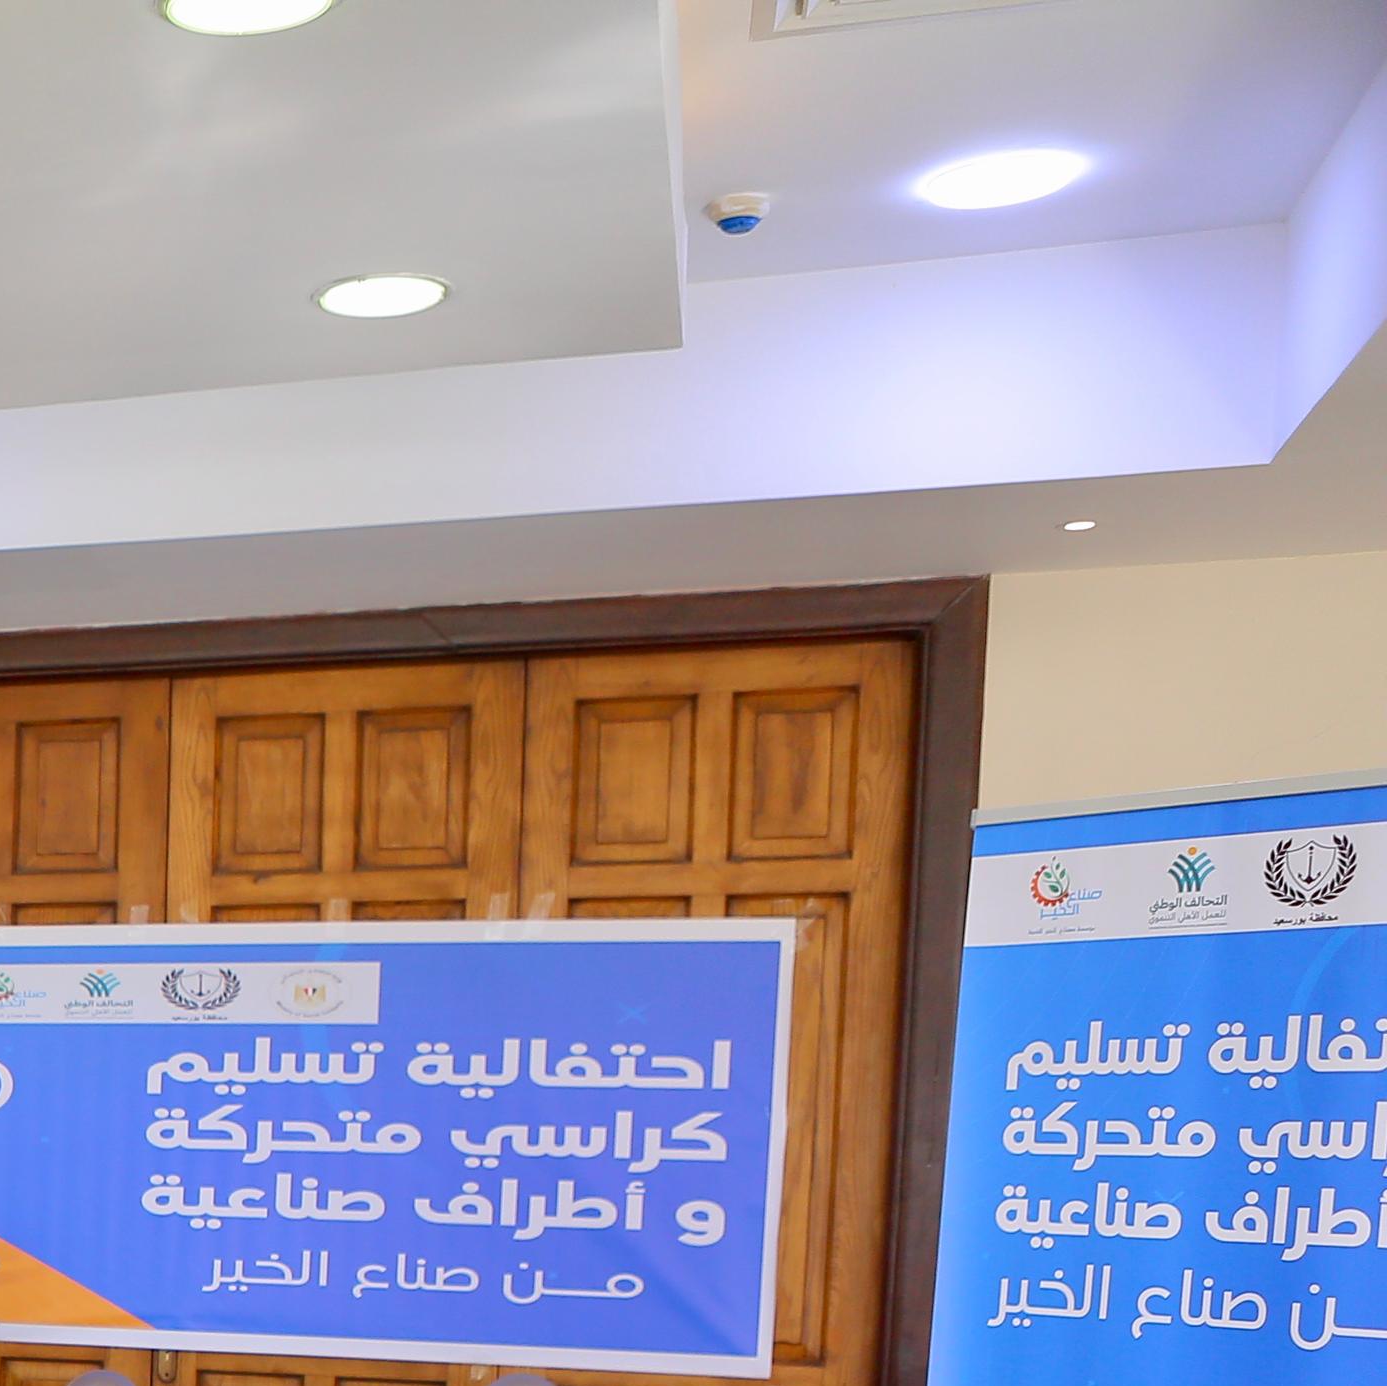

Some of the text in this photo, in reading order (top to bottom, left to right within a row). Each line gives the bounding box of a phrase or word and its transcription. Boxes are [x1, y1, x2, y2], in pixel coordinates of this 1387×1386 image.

[1067, 887, 1103, 908] صناع
[1149, 893, 1228, 915] التحالف الوطني
[1201, 908, 1227, 921] للعمل
[146, 1036, 733, 1100] احتفالية تسليم
[1004, 1020, 1191, 1091] تسليم
[145, 1103, 728, 1174] كراسي متحركة
[1002, 1101, 1217, 1172] متحركة
[141, 1172, 727, 1247] و أطراف صناعية
[994, 1181, 1183, 1250] صناعية
[201, 1249, 645, 1305] من صناع الخير
[986, 1263, 1113, 1328] الخير
[1131, 1268, 1268, 1340] صناع
